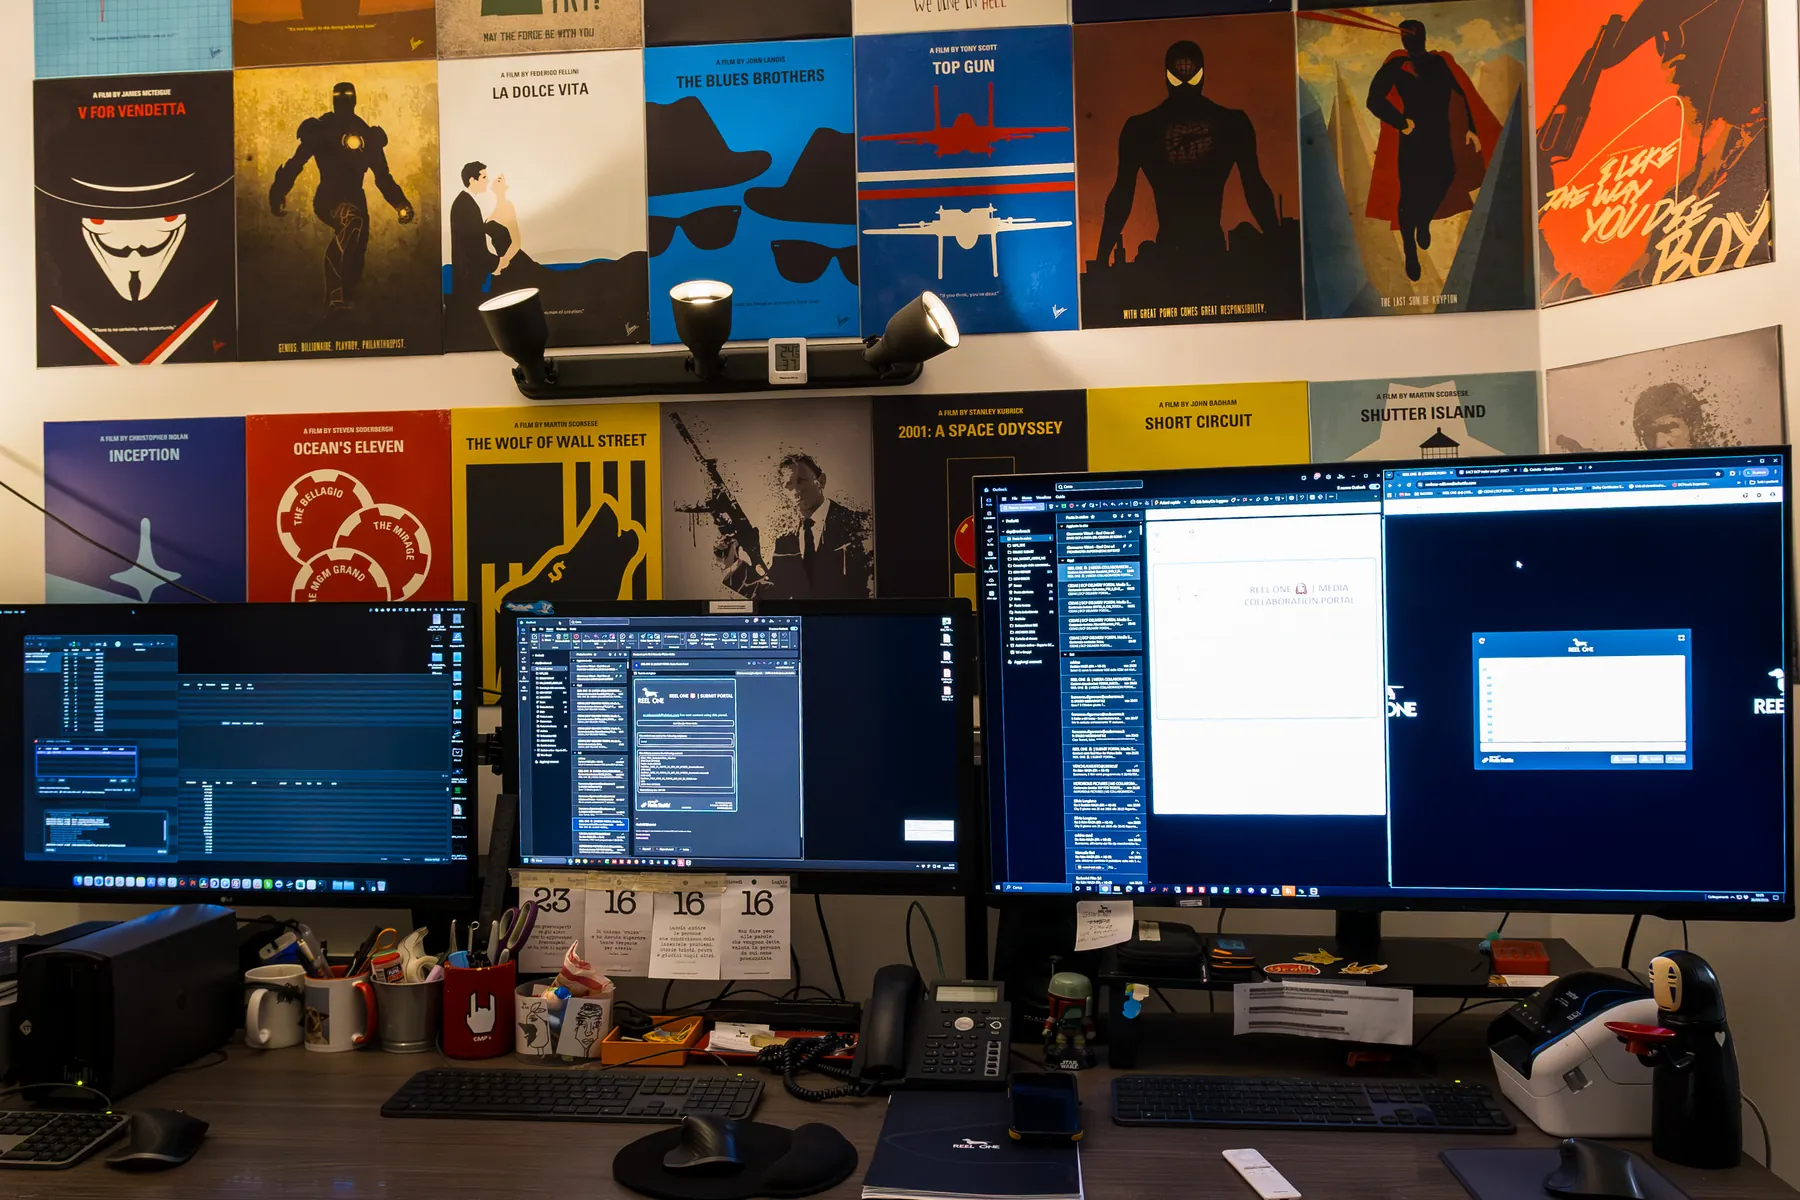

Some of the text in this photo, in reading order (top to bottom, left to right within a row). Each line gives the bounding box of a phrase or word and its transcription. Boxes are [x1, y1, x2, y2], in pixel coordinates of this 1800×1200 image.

[483, 27, 595, 42] MAY THE FORCE BE WITH YOU
[978, 44, 998, 52] SCOTT
[763, 56, 786, 64] LANDIS
[932, 59, 995, 75] TOP GUN
[530, 69, 557, 77] FEDERICO
[558, 68, 579, 76] FELLINI
[676, 68, 825, 88] THE BLUES BROTHERS
[121, 89, 141, 97] JAMES
[142, 88, 172, 97] MCTEIGUE
[492, 82, 589, 100] LA DOLCE VITA
[78, 101, 186, 120] V FOR VENDETTA
[1614, 146, 1677, 182] LIKE
[1593, 178, 1653, 207] WAY
[1581, 192, 1720, 243] YOU DIE
[1652, 198, 1772, 287] BOY
[1380, 294, 1458, 308] THE LAST SON OF KRYPTON
[1123, 309, 1138, 320] WITH
[1140, 308, 1157, 319] GREAT
[1159, 307, 1178, 318] POWER
[1180, 306, 1199, 317] COMES
[1200, 305, 1218, 316] GREAT
[1409, 391, 1435, 399] MARTIN
[1436, 390, 1469, 398] SCORSESE
[969, 408, 996, 416] STANLEY
[997, 407, 1024, 415] KUBRICK
[1361, 404, 1486, 423] SHUTTER ISLAND
[333, 426, 354, 434] STEVEN
[898, 421, 1063, 439] 2001: A SPACE ODYSSEY
[1145, 413, 1253, 430] SHORT CIRCUIT
[293, 440, 404, 455] OCEAN'S ELEVEN
[466, 433, 647, 450] THE WOLF OF WALL STREET
[109, 448, 180, 462] INCEPTION
[294, 487, 344, 526] THE BELLAGIO
[373, 521, 415, 560] THE MIRAGE
[311, 565, 366, 591] MGM GRAND
[547, 560, 567, 583] $
[1250, 586, 1270, 594] REEL
[1272, 585, 1290, 593] ONE
[1318, 584, 1349, 592] MEDIA
[1244, 596, 1354, 606] COLLABORATION PORTAL
[534, 887, 571, 912] 23
[605, 890, 636, 915] 16
[673, 891, 705, 915] 16
[741, 890, 774, 916] 16
